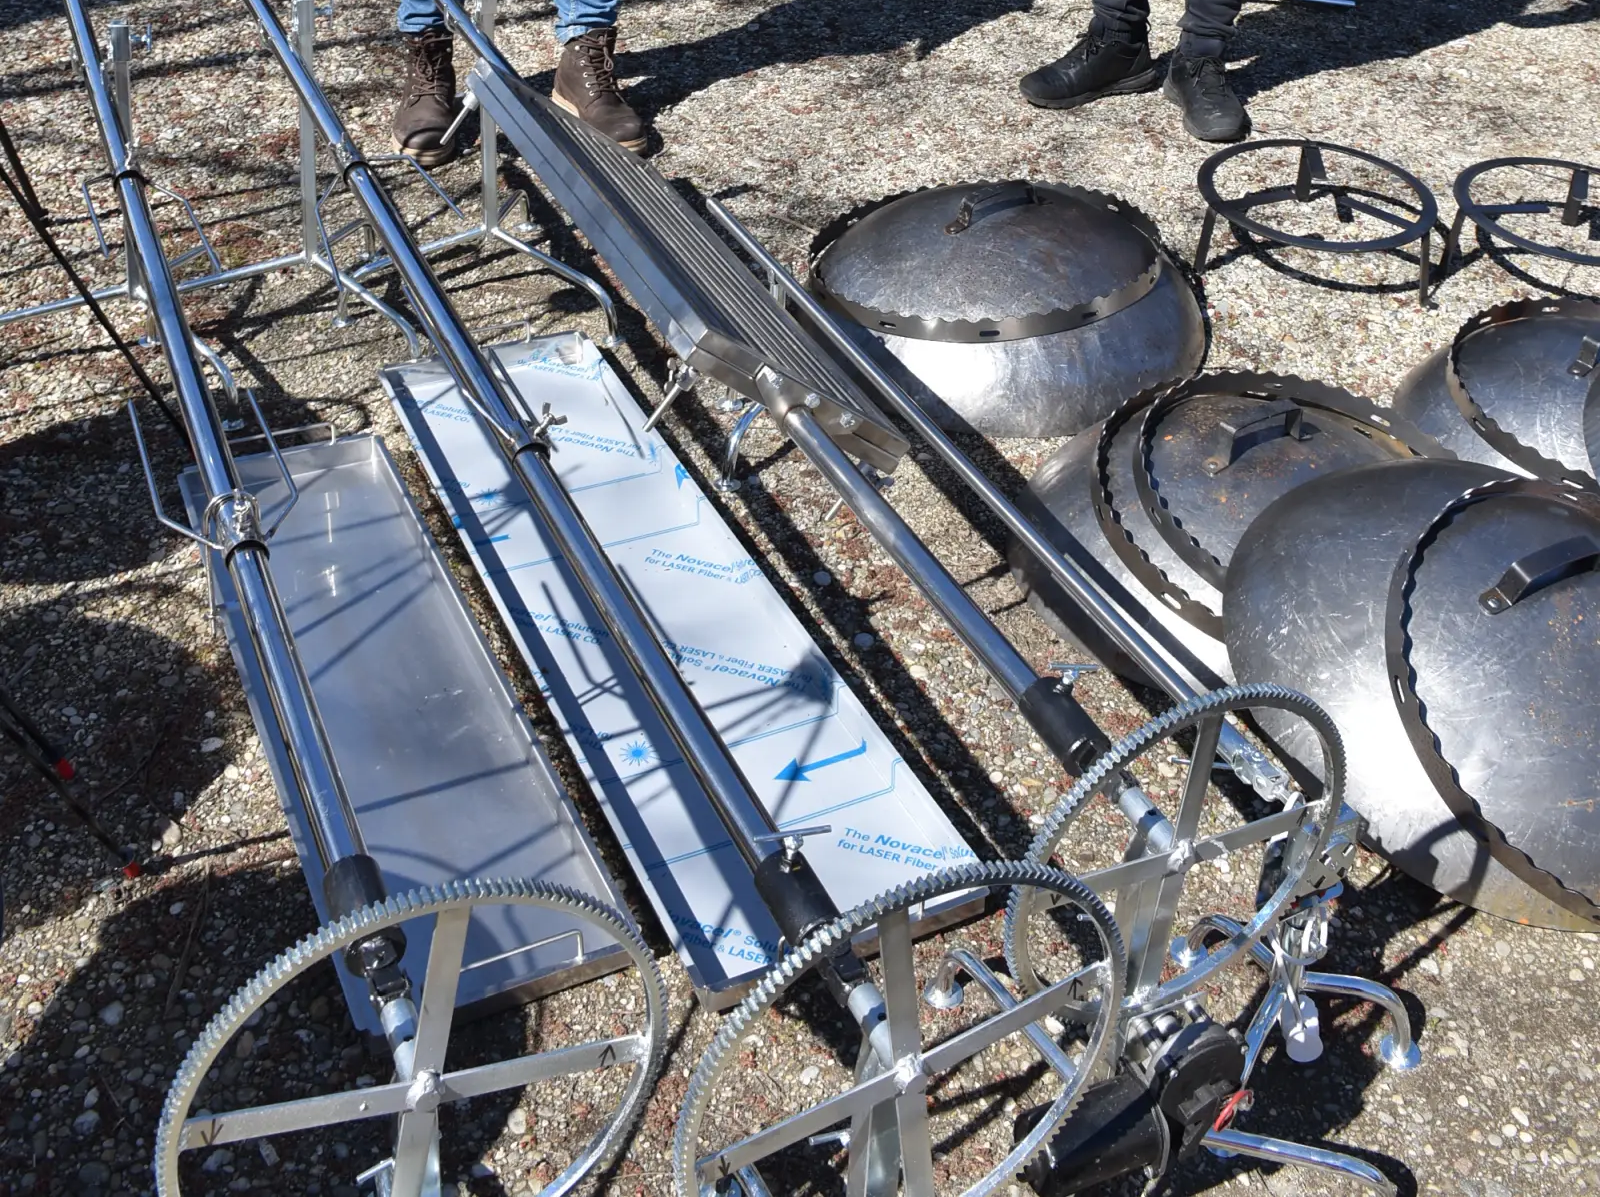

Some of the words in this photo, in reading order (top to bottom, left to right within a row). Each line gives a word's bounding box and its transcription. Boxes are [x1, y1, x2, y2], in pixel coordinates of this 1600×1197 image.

[651, 548, 672, 559] The
[644, 556, 660, 564] for
[661, 560, 696, 573] LASER
[697, 568, 726, 580] Fiber
[546, 625, 581, 640] LASER
[560, 618, 609, 637] Solution
[679, 644, 716, 659] LASER
[725, 656, 756, 669] Fiber
[757, 663, 795, 677] LASER
[844, 827, 870, 841] The
[837, 839, 858, 850] for
[859, 844, 902, 862] LASER
[904, 856, 939, 872] Fiber
[681, 932, 717, 950] Fiber
[727, 945, 773, 965] LASER
